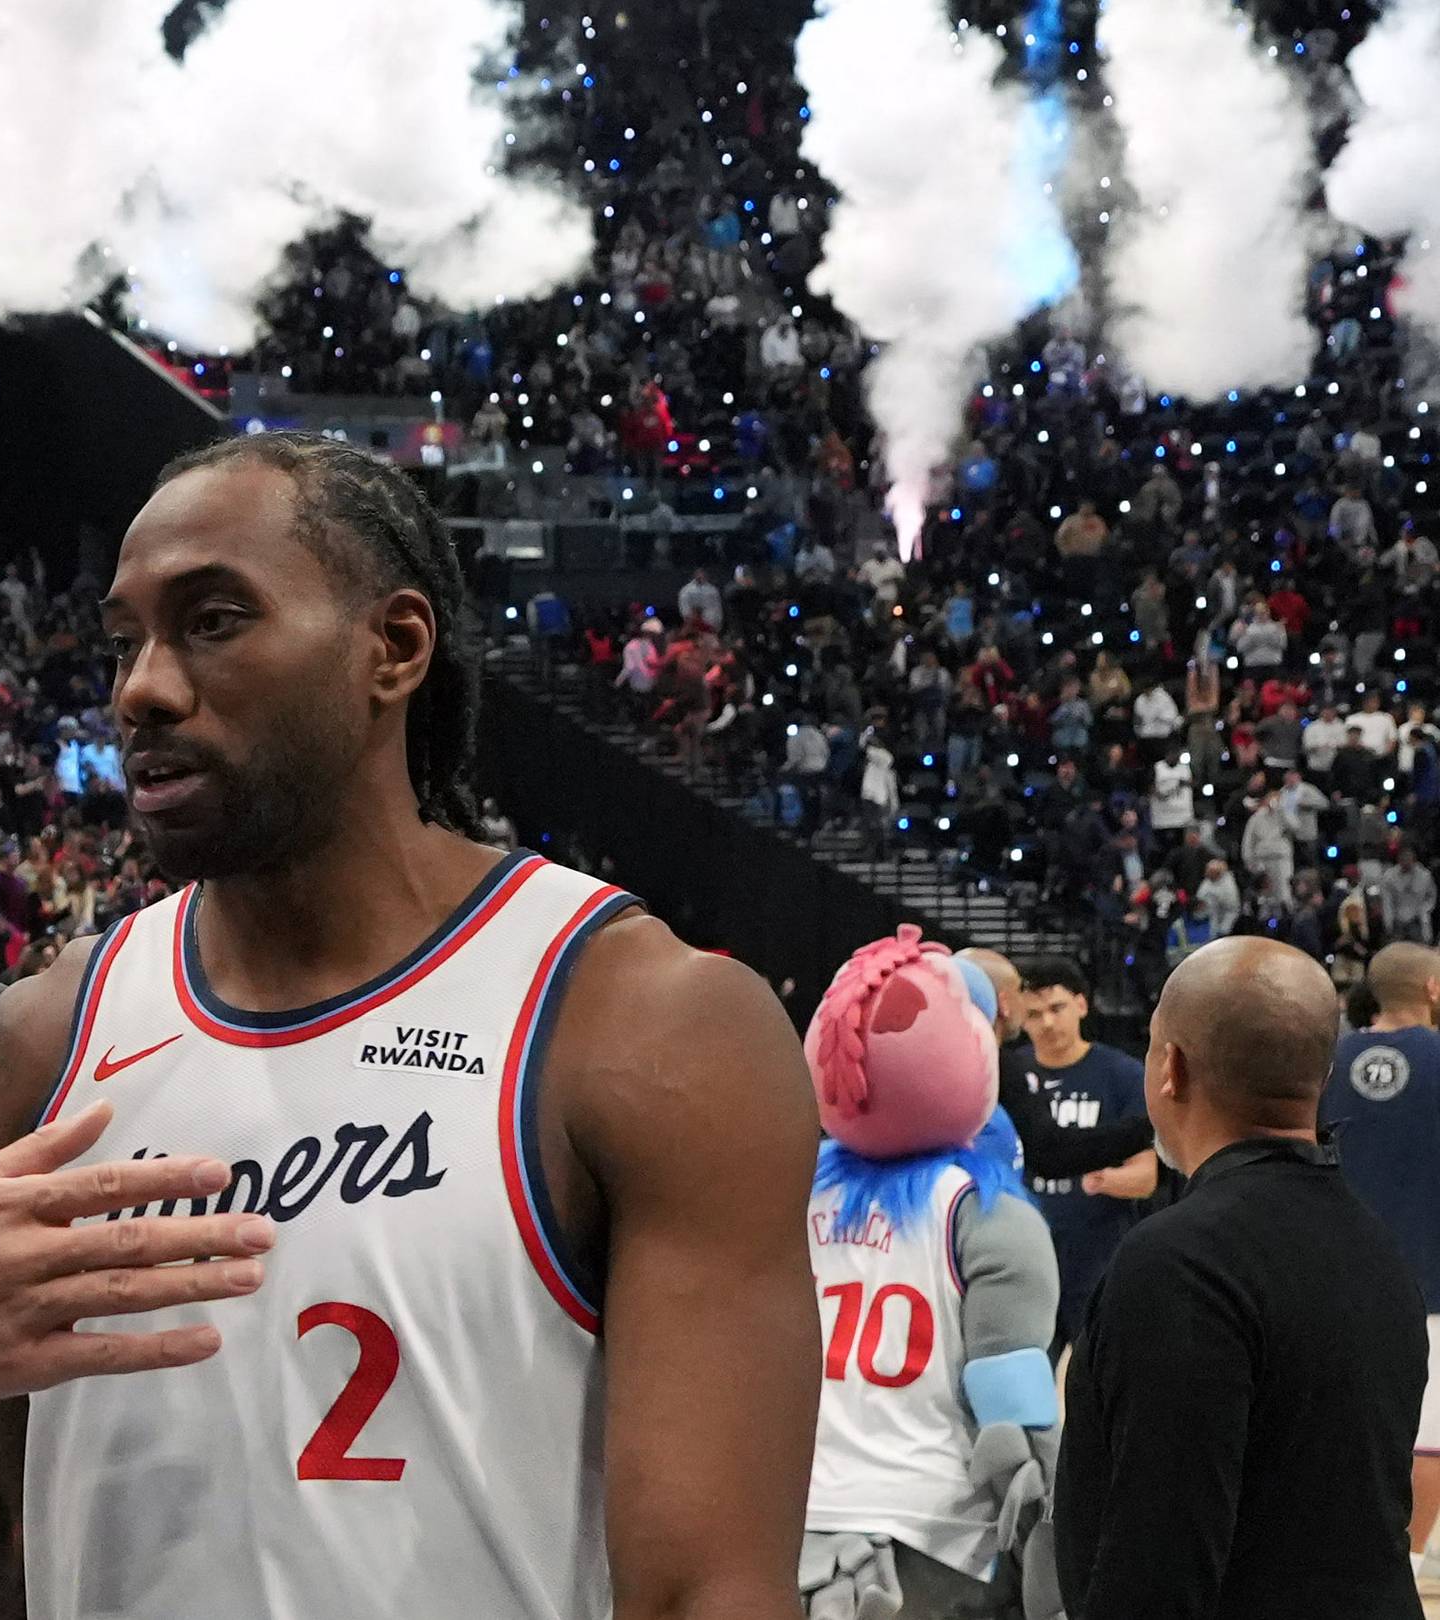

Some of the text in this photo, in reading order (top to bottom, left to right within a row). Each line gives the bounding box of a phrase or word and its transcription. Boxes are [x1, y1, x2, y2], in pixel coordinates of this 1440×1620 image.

[396, 1026, 469, 1051] VISIT
[360, 1044, 485, 1075] RWANDA
[297, 1302, 407, 1482] 2
